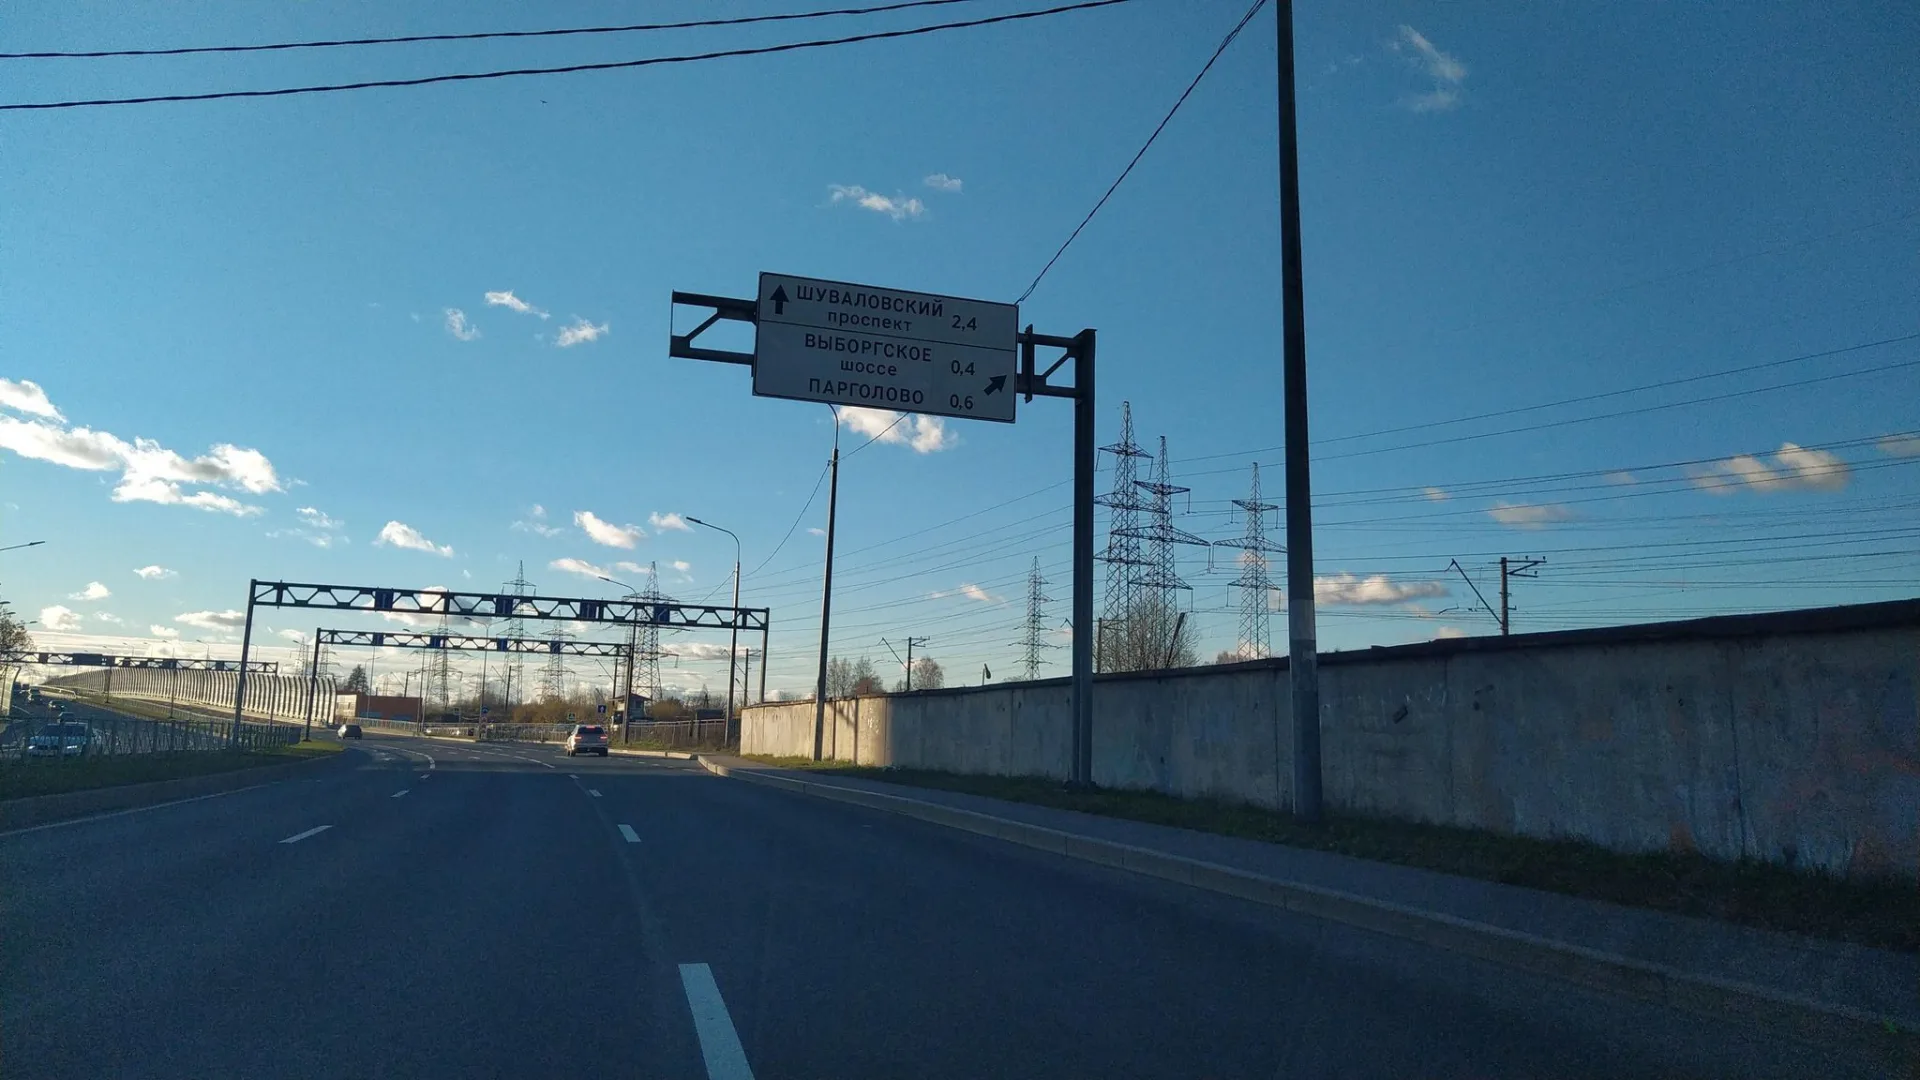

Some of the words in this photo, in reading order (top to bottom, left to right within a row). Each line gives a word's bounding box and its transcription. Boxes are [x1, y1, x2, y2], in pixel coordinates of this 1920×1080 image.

[796, 284, 944, 317] ШУВАЛОВСКИЙ
[951, 315, 978, 333] 2,4
[827, 309, 913, 332] проспект
[804, 333, 933, 362] ВЫБОРГСКОЕ
[840, 360, 898, 376] шоссе
[950, 360, 976, 377] 0,4
[808, 378, 924, 405] ПАРГОЛОВО
[949, 394, 974, 411] 0,6
